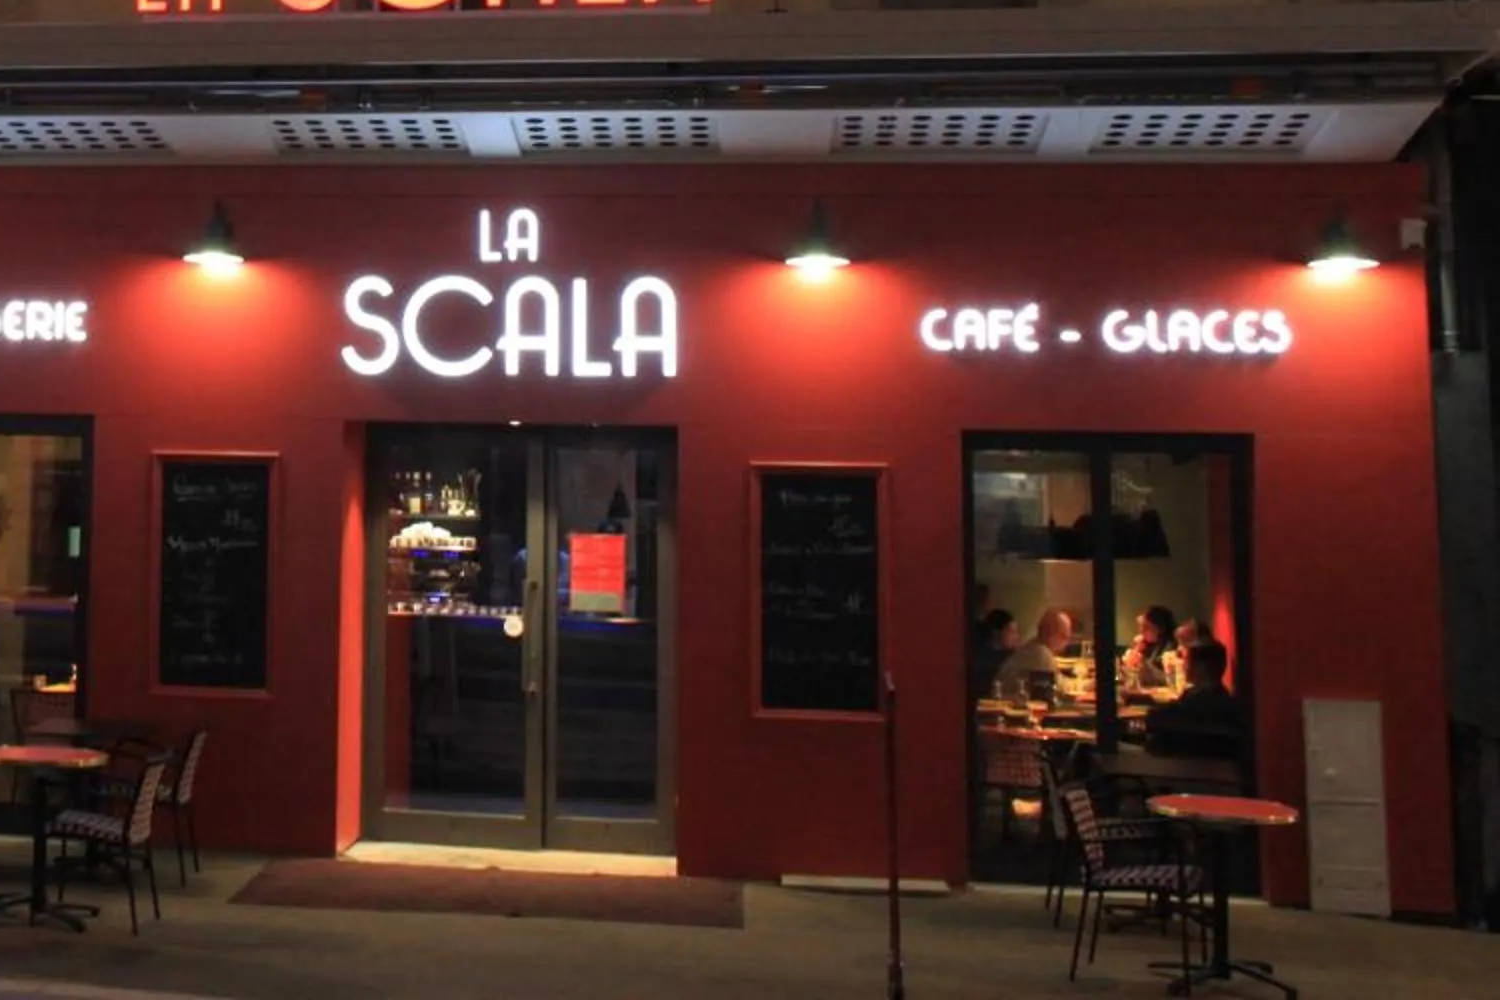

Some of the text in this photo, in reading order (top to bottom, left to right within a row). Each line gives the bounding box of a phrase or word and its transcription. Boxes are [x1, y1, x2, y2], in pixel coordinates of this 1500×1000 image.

[478, 207, 540, 262] LA
[340, 274, 678, 378] SCALA
[919, 302, 1041, 354] CAFÉ
[1101, 309, 1294, 355] GLACES
